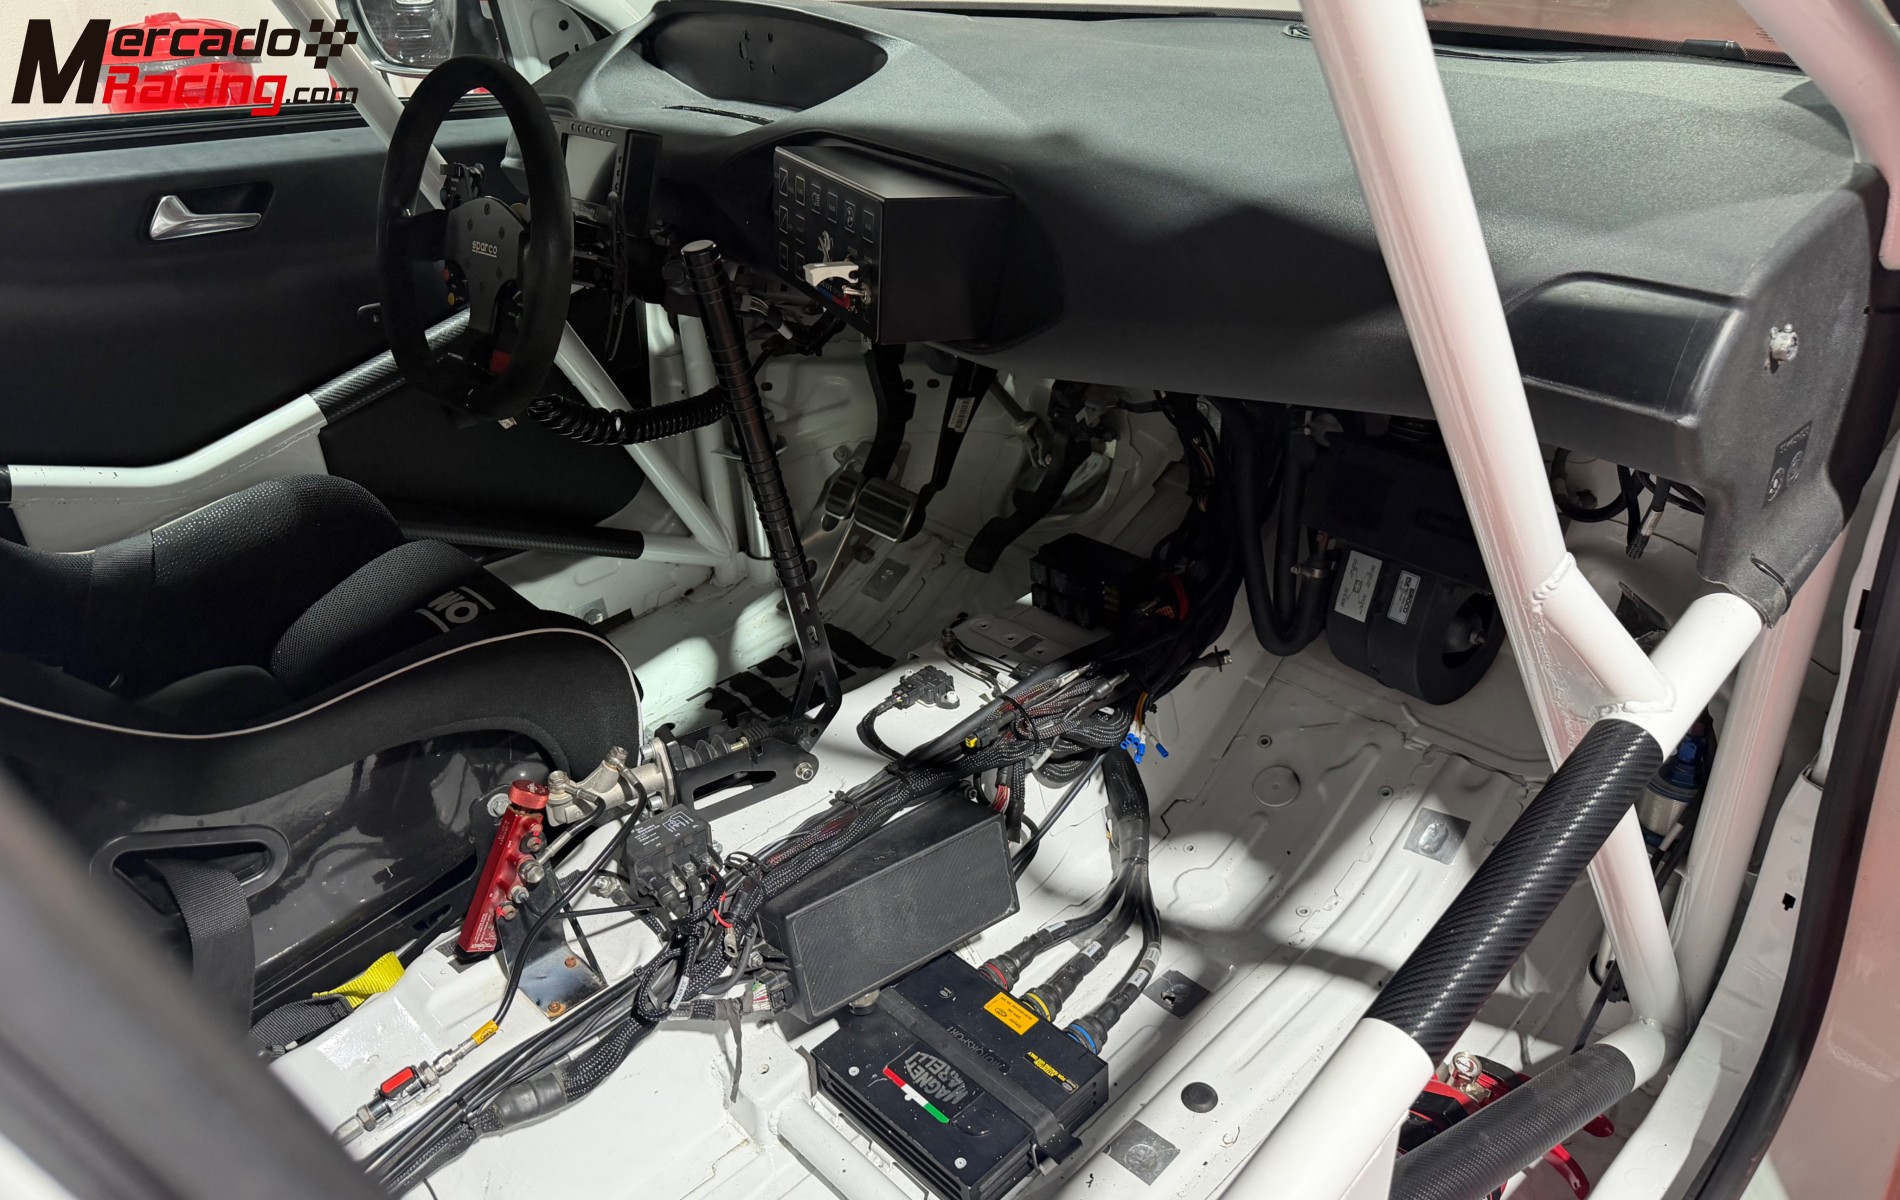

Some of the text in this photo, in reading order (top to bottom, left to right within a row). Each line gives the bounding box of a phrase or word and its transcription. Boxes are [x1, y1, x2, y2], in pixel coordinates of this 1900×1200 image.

[472, 240, 498, 255] sparco
[905, 1054, 966, 1104] MAGNETI
[906, 1051, 968, 1100] MARELLI
